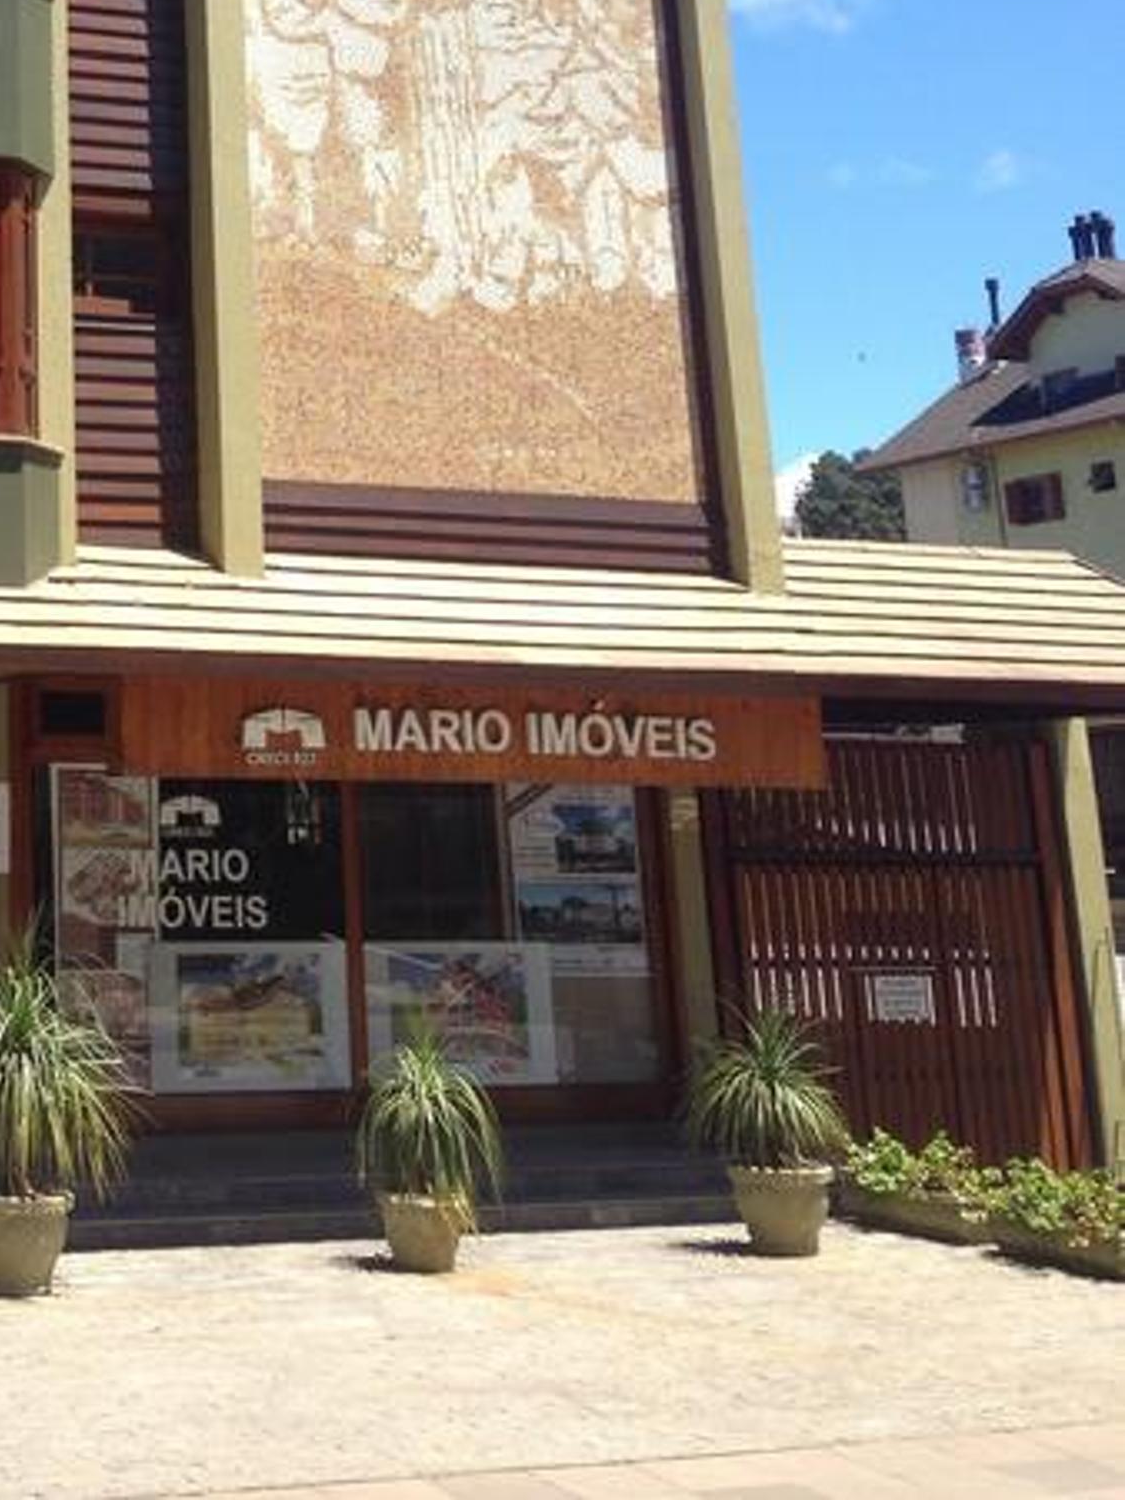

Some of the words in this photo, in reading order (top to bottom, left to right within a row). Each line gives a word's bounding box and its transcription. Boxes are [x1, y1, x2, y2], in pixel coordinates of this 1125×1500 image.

[353, 708, 510, 753] MARIO
[527, 701, 716, 762] IMÓVEIS
[127, 848, 250, 882] MARIO
[117, 886, 268, 928] IMÓVEIS
